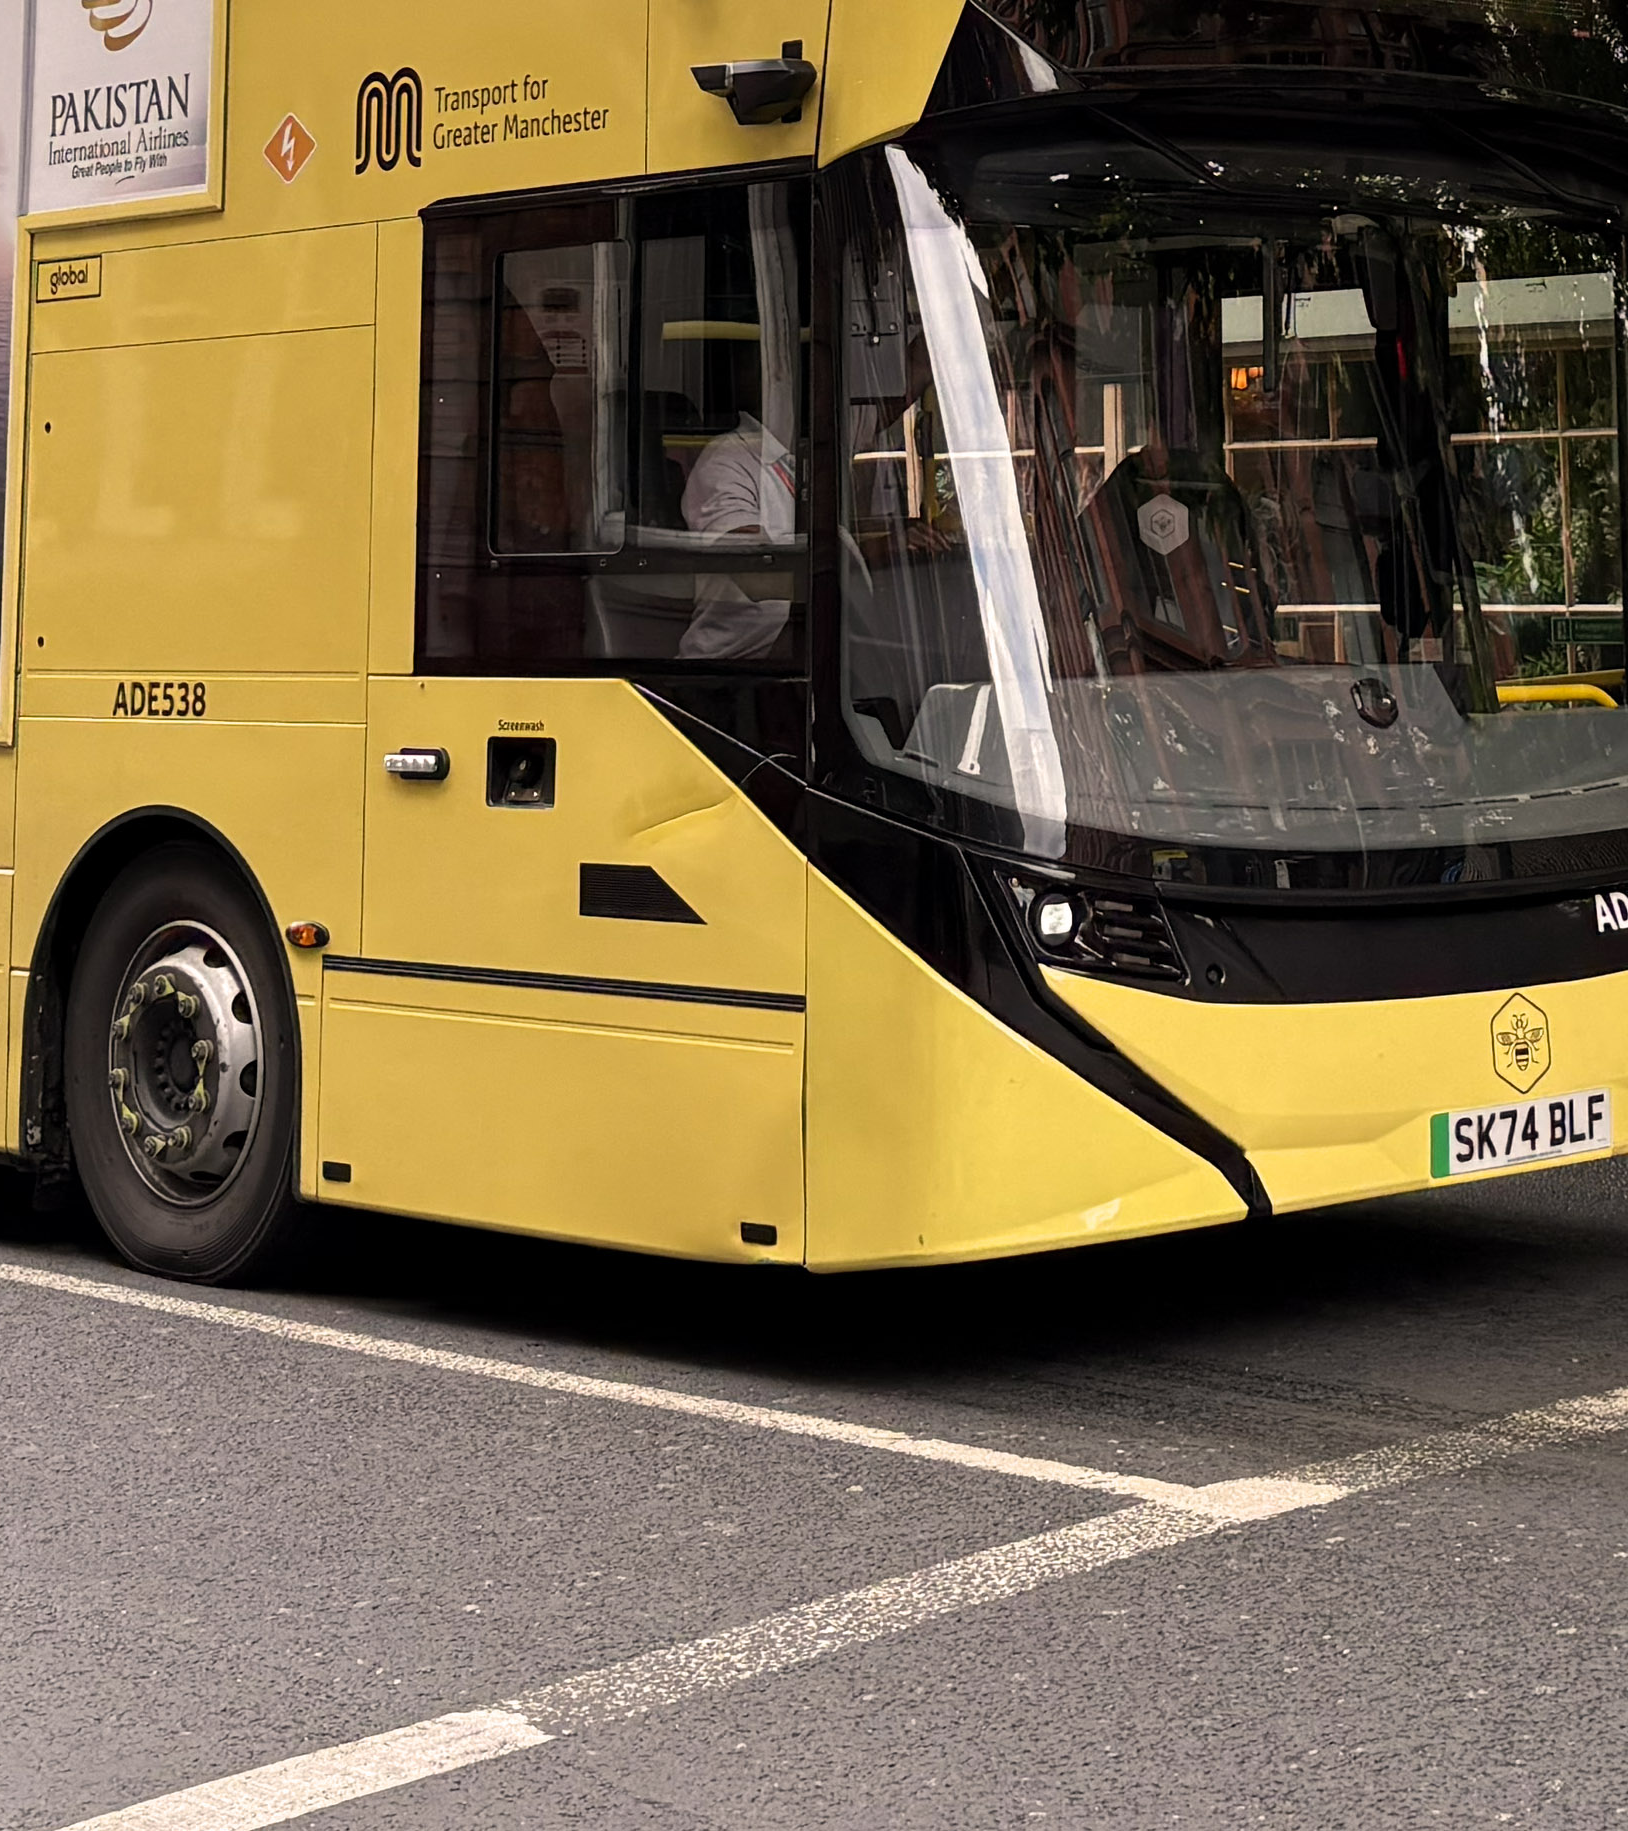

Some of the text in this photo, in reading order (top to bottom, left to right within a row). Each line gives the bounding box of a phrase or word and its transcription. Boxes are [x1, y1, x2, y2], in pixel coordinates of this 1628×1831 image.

[50, 73, 190, 137] PAKISTAN
[434, 74, 549, 115] Transport for
[49, 126, 189, 166] International Airlines
[433, 107, 609, 150] Greater Manchester
[72, 153, 168, 179] Great People to Fly With
[50, 262, 89, 295] global
[112, 681, 206, 717] ADE538
[498, 719, 545, 731] Screenwash
[1454, 1093, 1605, 1164] SK74 BLF
